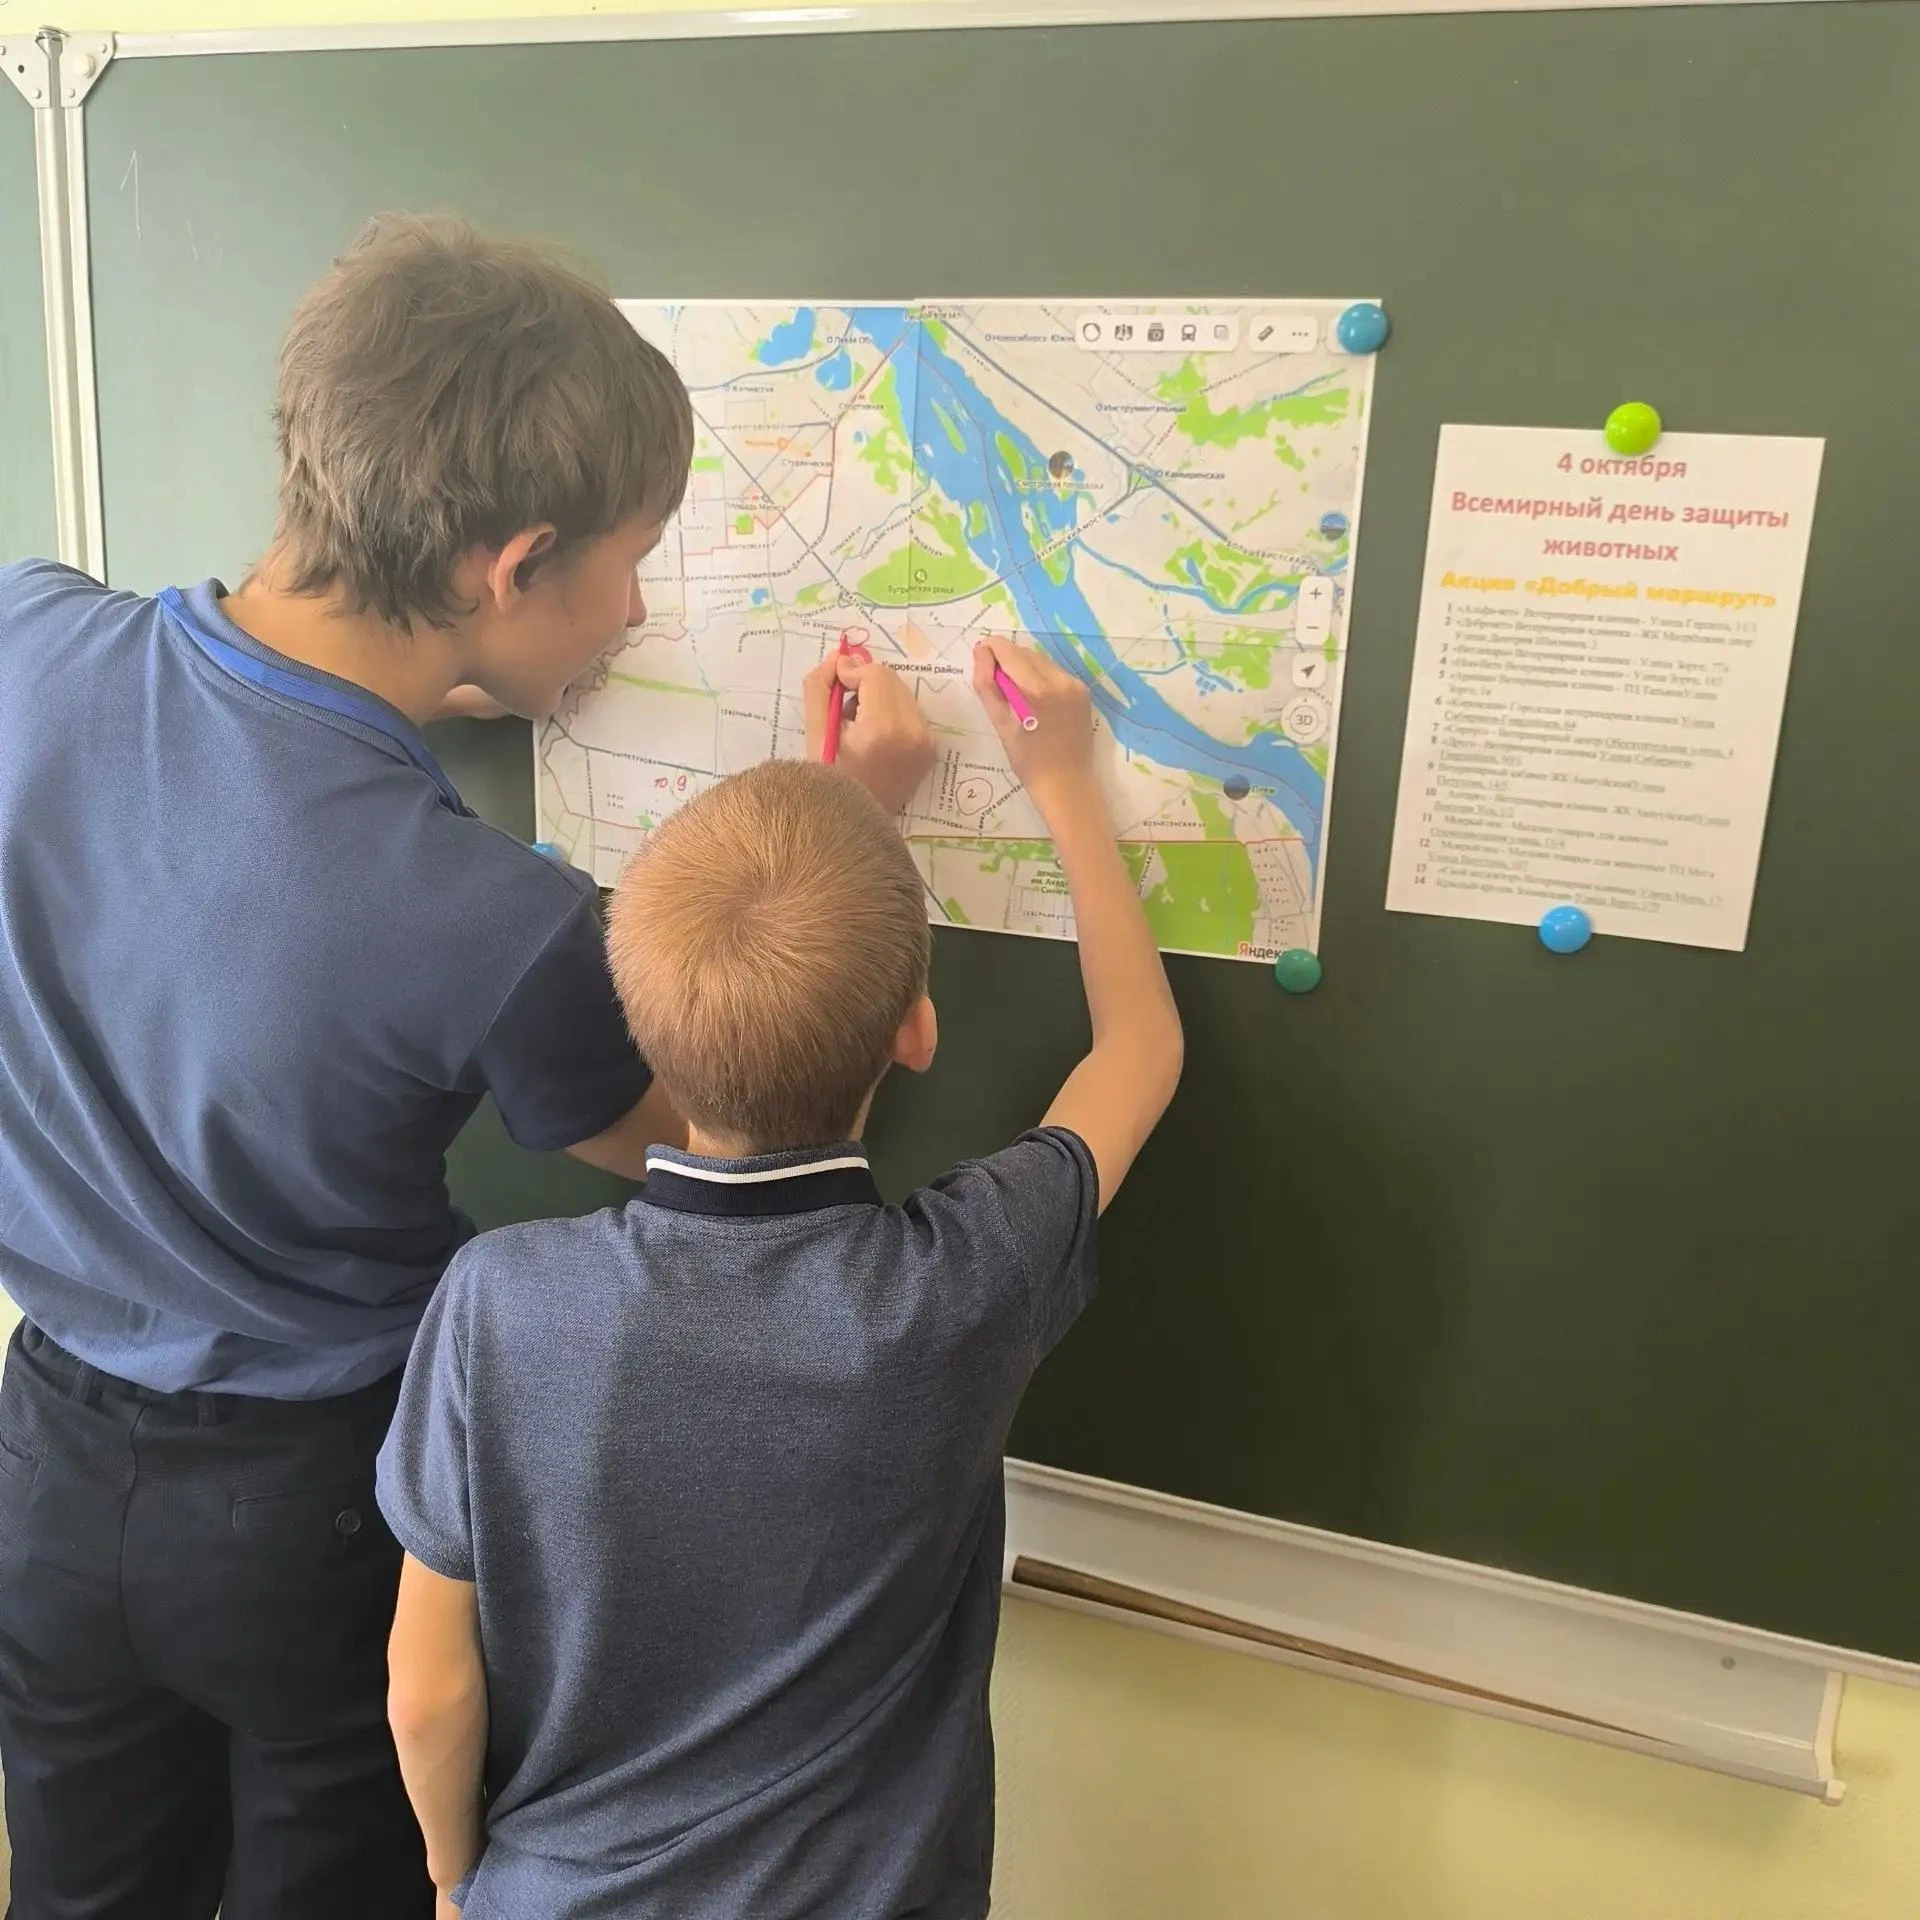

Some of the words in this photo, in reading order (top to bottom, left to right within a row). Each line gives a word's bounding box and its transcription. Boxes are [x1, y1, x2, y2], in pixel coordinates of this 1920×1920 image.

[1557, 452, 1573, 474] 4
[1580, 454, 1688, 482] октября
[1451, 491, 1602, 521] Всемирный
[1608, 500, 1674, 524] день
[1681, 506, 1789, 529] защиты
[1542, 538, 1680, 562] животных
[1440, 570, 1516, 593] Акция
[1524, 576, 1637, 601] «Добрый
[1646, 585, 1777, 611] маршрут»
[934, 664, 964, 676] район
[1294, 713, 1313, 727] 3D
[653, 776, 669, 789] 10
[967, 787, 977, 799] 2
[1239, 942, 1283, 960] Яндек
